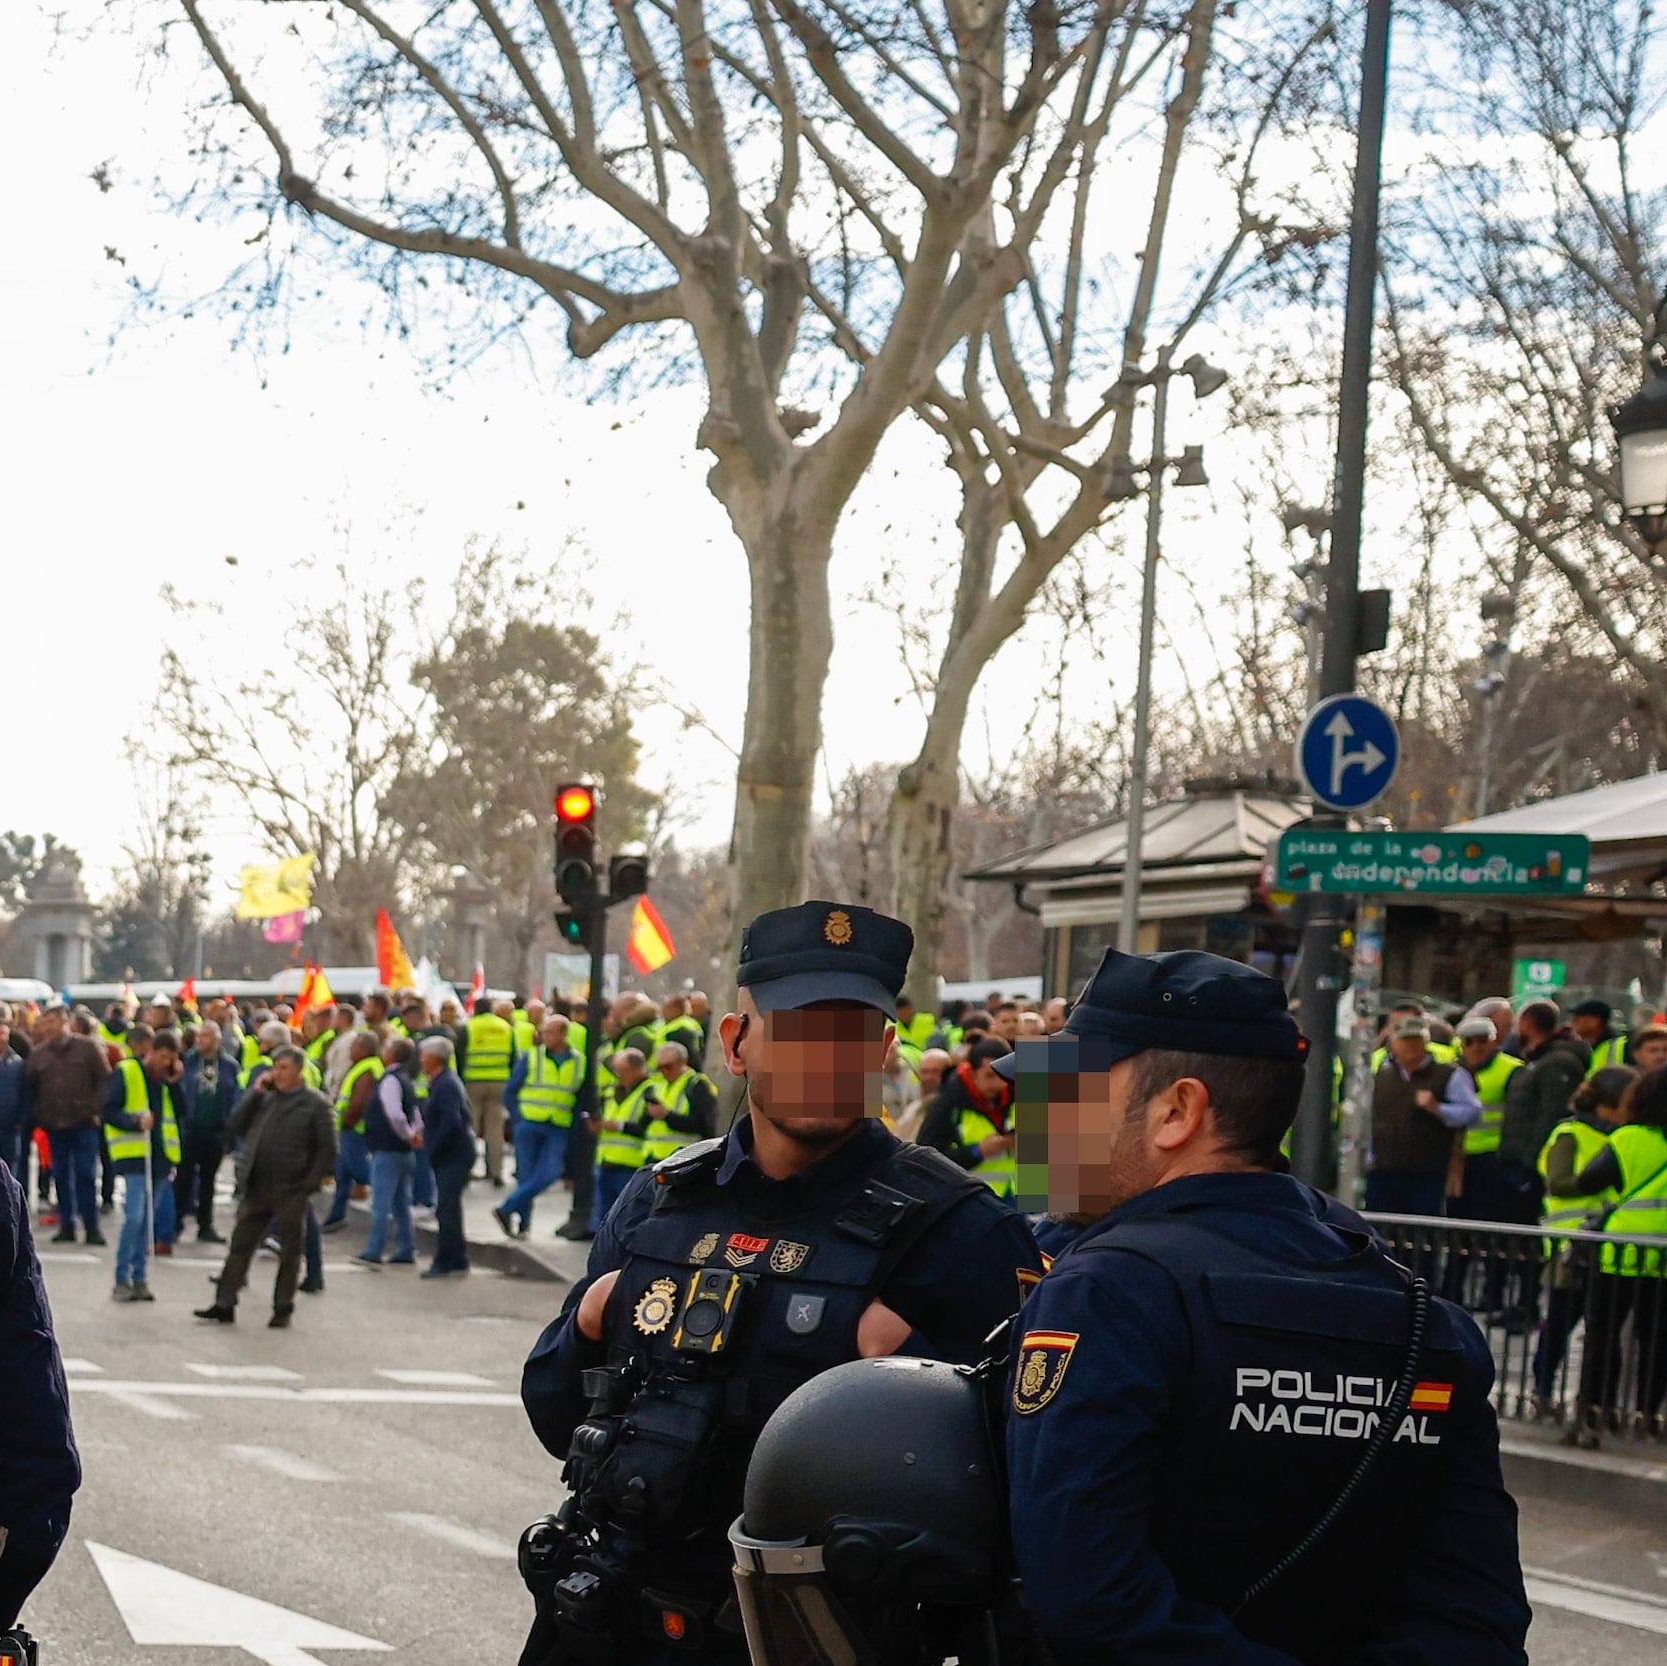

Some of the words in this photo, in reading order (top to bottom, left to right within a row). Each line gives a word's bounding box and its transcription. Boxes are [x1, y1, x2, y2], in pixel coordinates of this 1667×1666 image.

[1288, 842, 1337, 856] plaza
[1351, 841, 1373, 855] de
[1385, 841, 1401, 855] la
[1332, 860, 1529, 886] ndependnia
